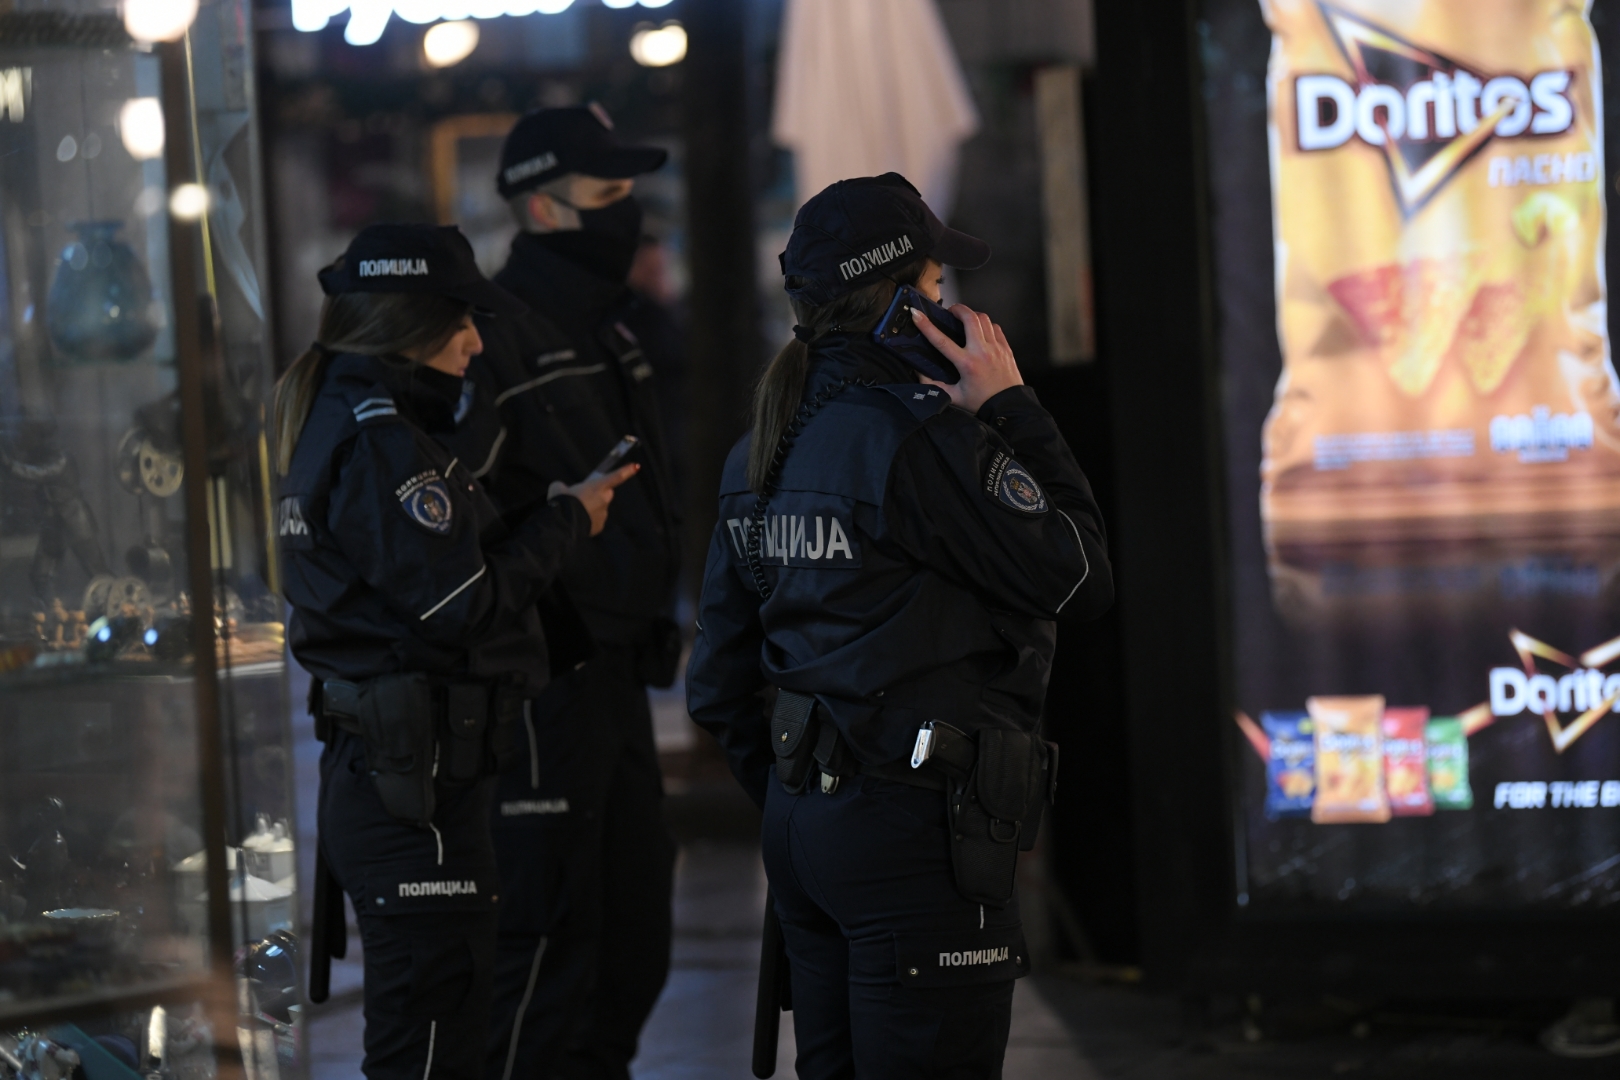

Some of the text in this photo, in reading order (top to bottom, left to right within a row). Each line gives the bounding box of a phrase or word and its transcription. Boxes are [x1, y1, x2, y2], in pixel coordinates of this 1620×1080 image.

[1296, 69, 1572, 150] Doritos
[1488, 153, 1594, 187] NACHO
[359, 258, 429, 277] ПОЛИЦИЈА
[840, 235, 914, 280] ПОЛИЦИЈА
[1494, 781, 1547, 809] FOR
[1549, 780, 1599, 808] THE
[399, 881, 477, 897] ПОЛИЦИЈА
[939, 946, 1009, 967] ПОЛИЦИЈА
